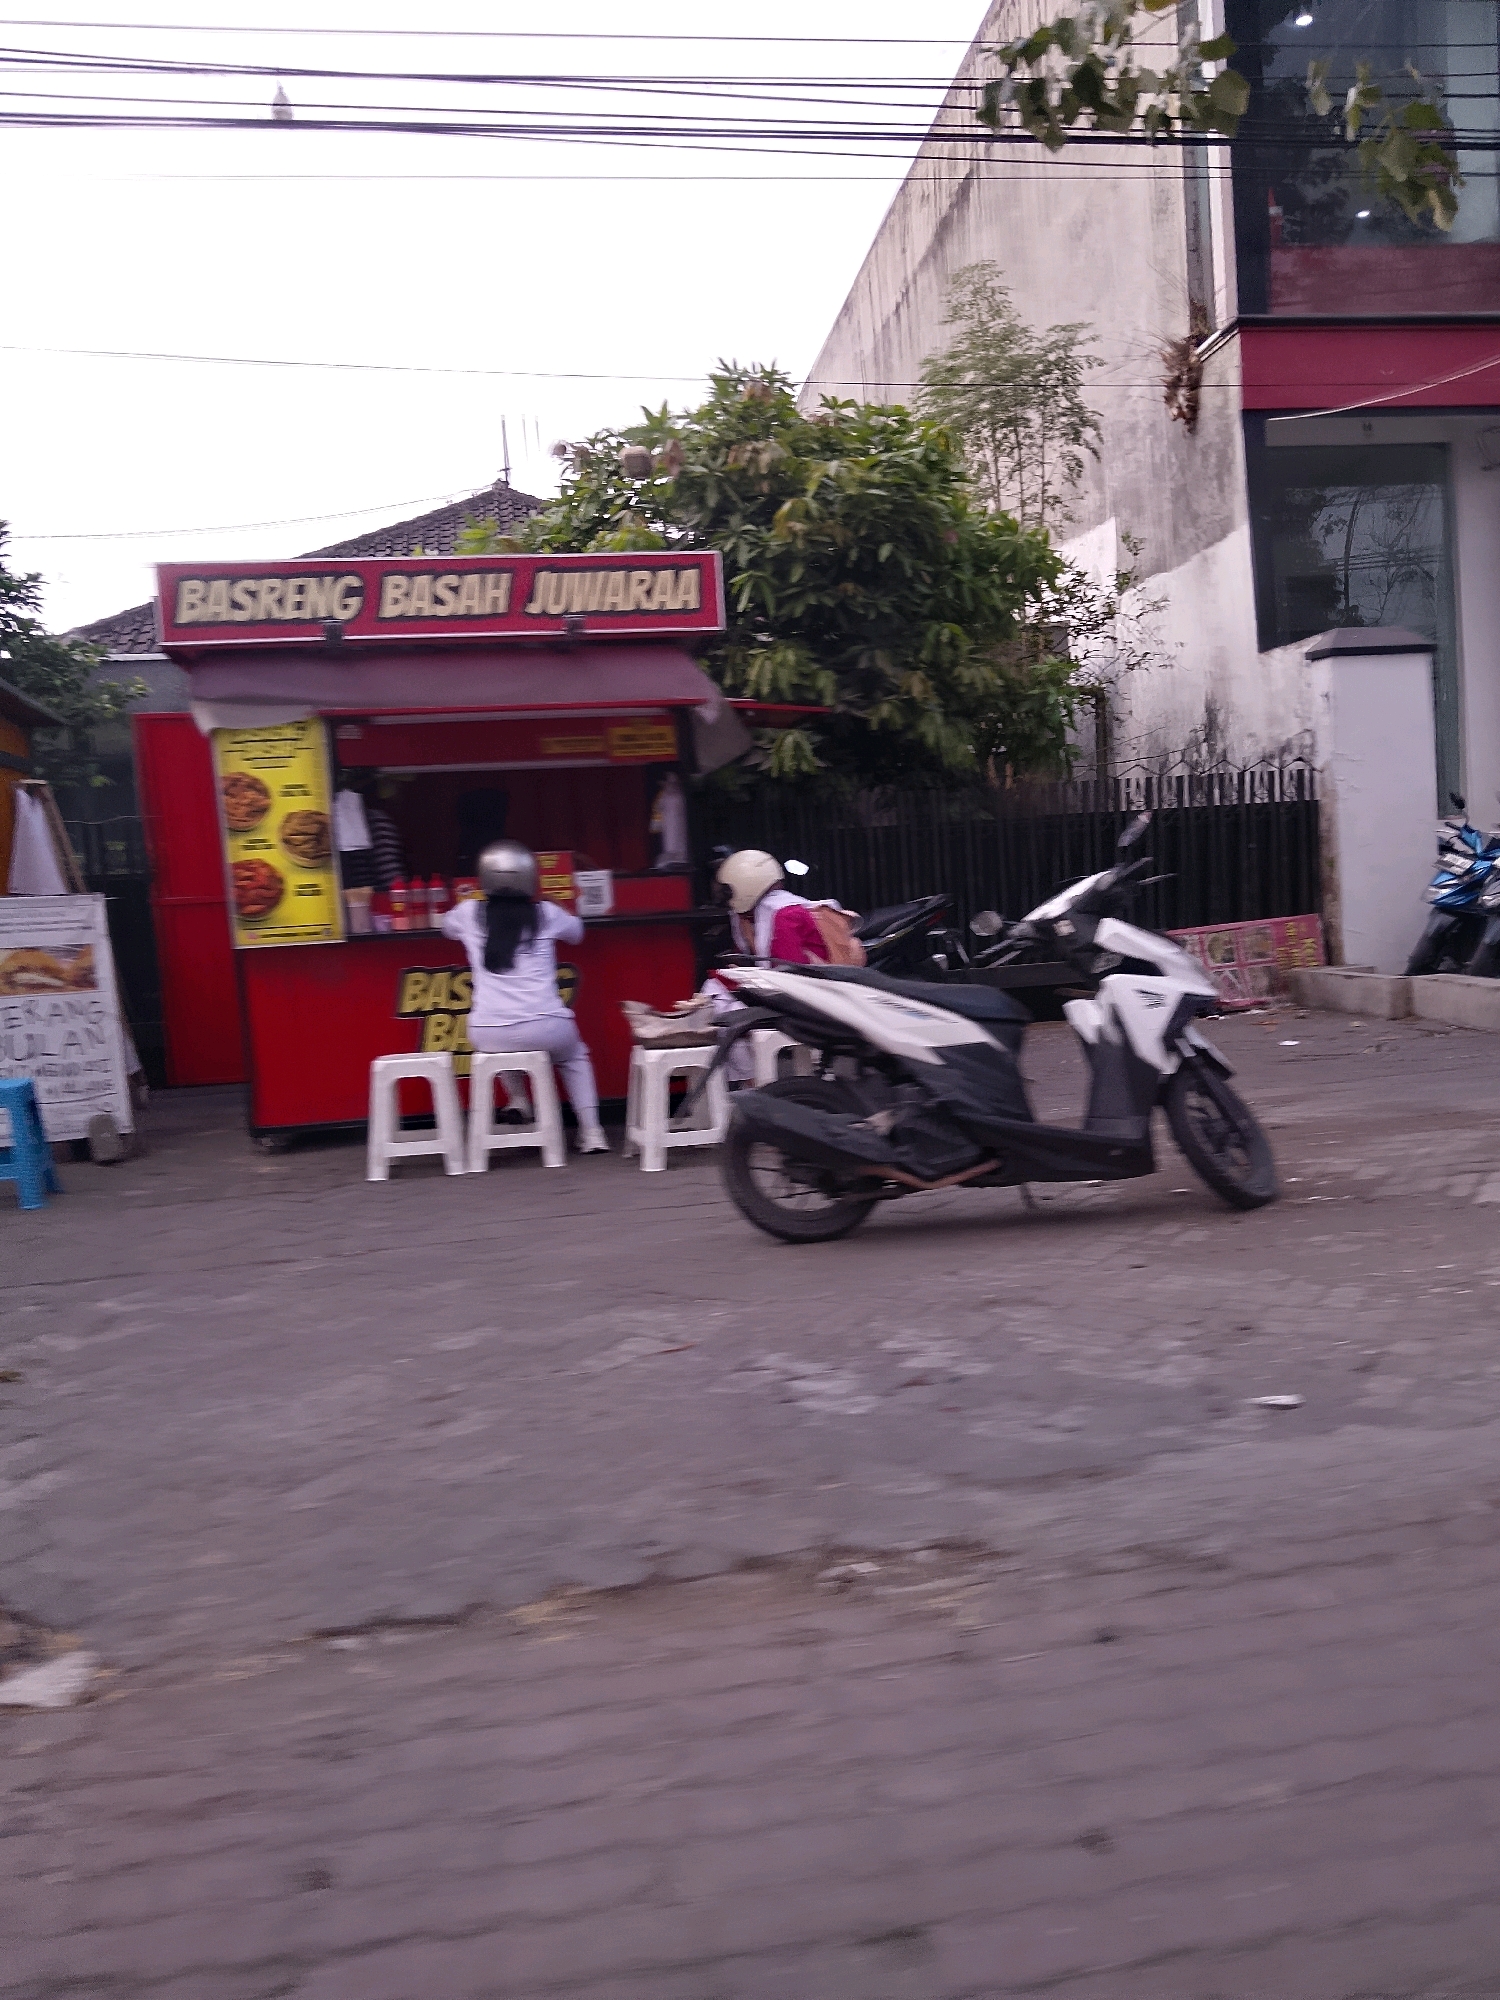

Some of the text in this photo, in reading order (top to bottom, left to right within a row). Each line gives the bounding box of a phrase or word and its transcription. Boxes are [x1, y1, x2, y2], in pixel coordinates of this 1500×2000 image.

[175, 567, 701, 624] BASRENG BASAH JUWARAA
[0, 998, 106, 1029] ERANG
[0, 1026, 107, 1062] ULAN
